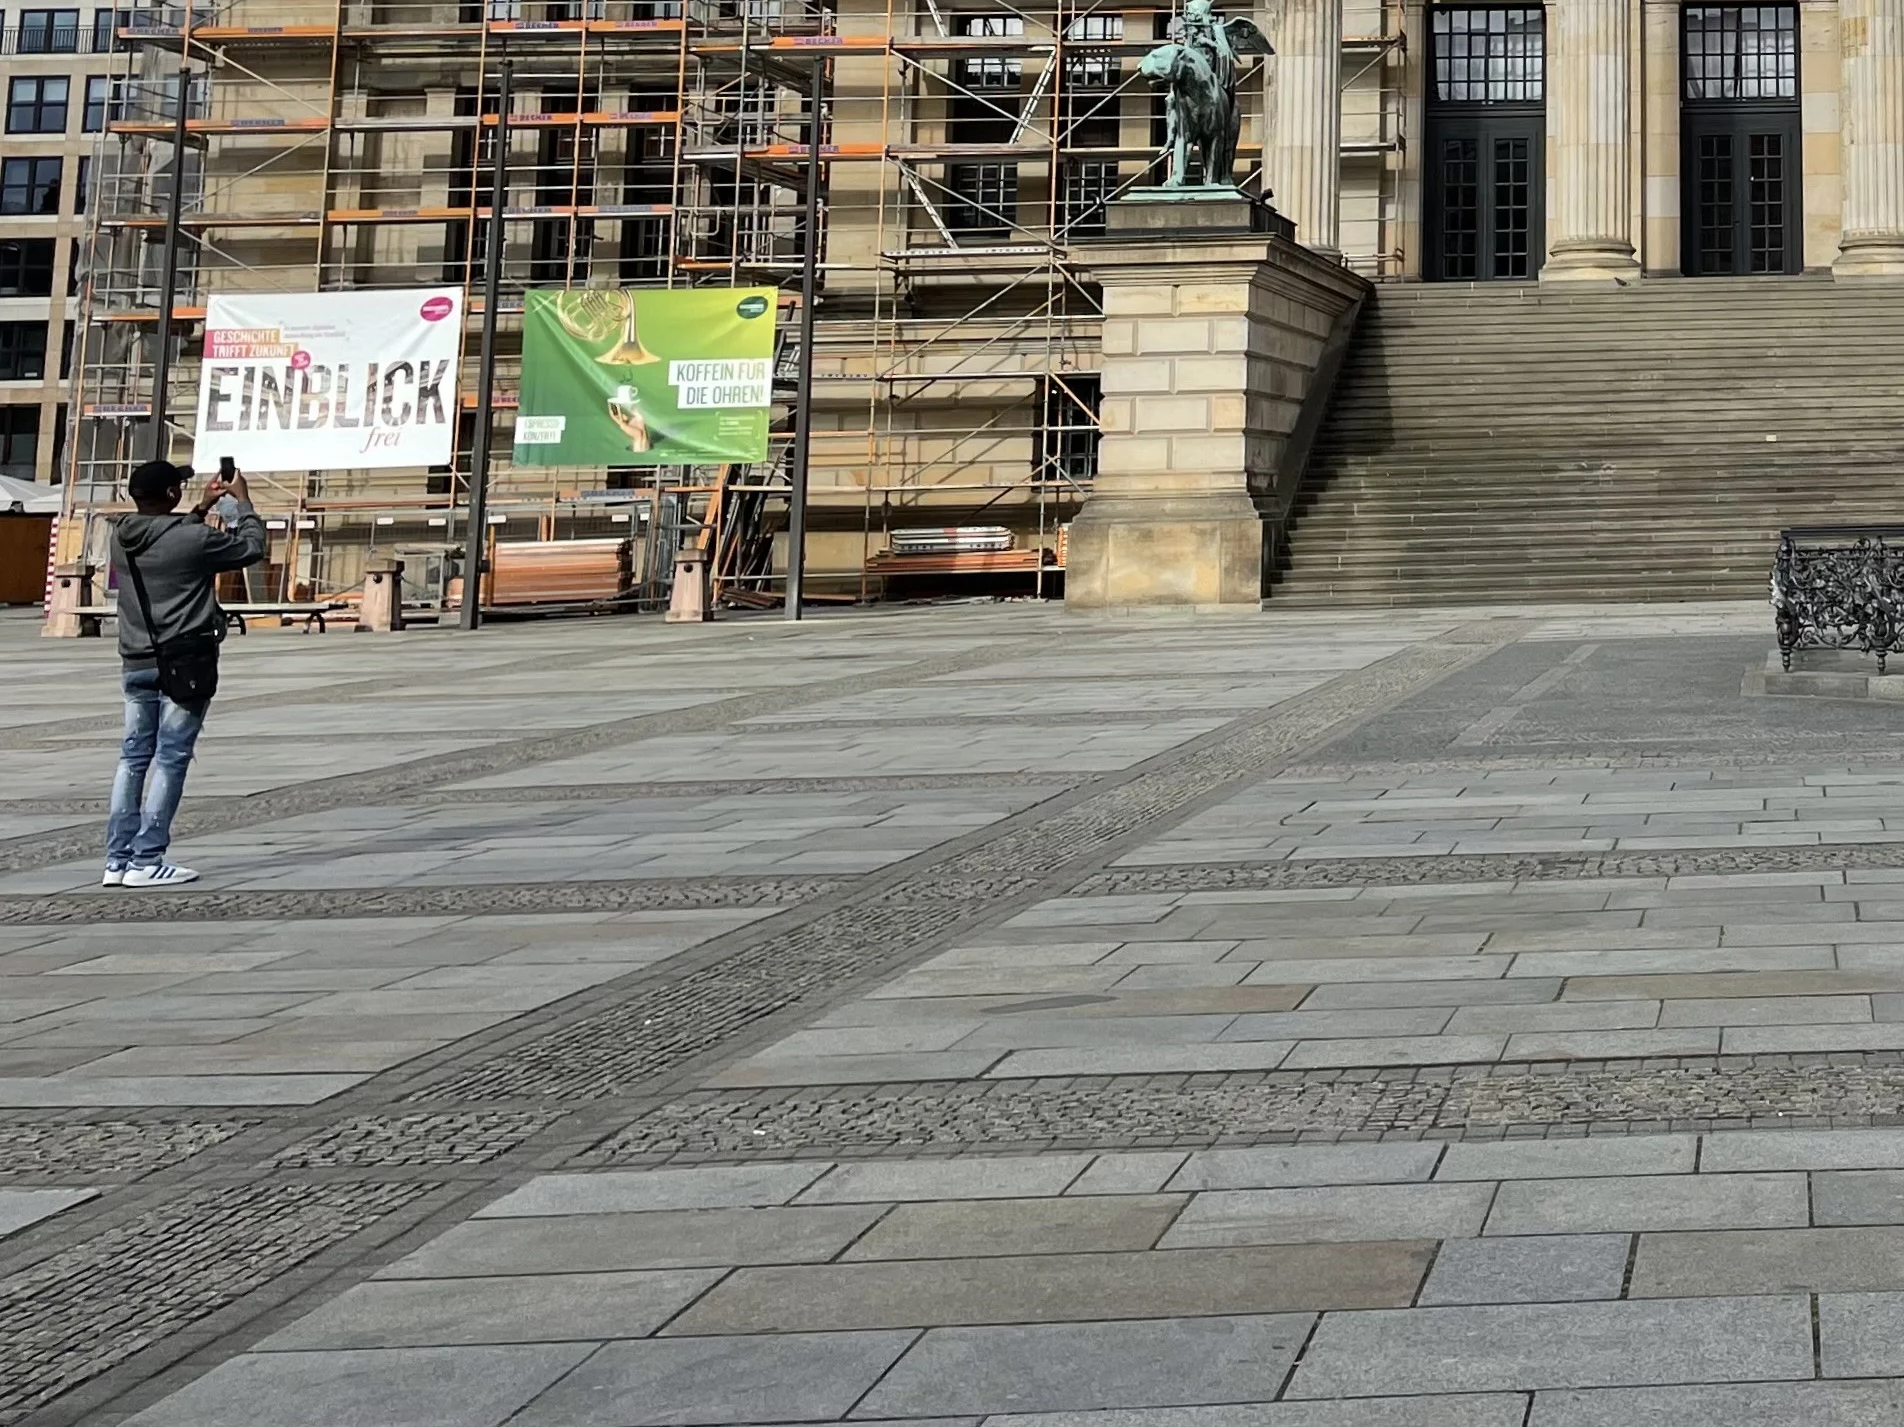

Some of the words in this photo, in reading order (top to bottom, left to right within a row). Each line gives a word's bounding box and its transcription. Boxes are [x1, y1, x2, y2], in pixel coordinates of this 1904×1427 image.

[213, 329, 277, 344] GESCHICHTE
[213, 344, 248, 358] TRIFFT
[249, 343, 295, 358] ZUKUNFT
[676, 363, 735, 383] KOFFEIN
[205, 359, 450, 432] EINBLICK
[686, 387, 708, 405] DIE
[711, 385, 765, 404] OHREN!
[359, 426, 402, 455] frei
